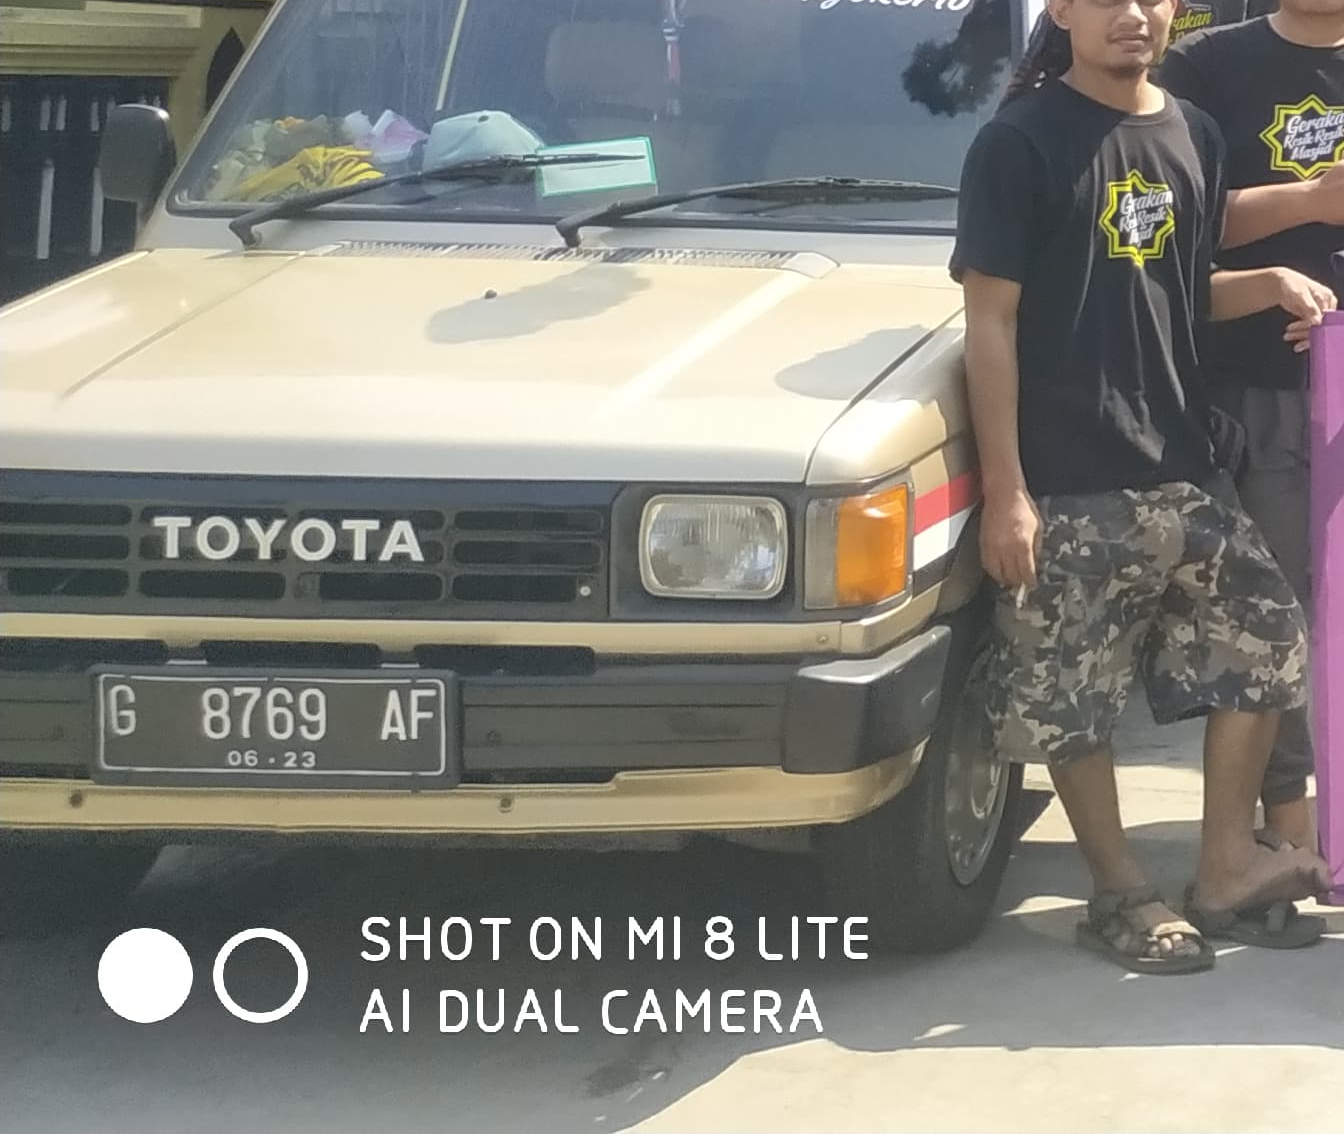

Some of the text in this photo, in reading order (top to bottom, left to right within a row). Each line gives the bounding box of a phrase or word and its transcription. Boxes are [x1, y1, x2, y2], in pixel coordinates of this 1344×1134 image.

[1290, 139, 1335, 161] Masjid
[153, 515, 425, 562] TOYOTA
[109, 683, 437, 742] G 8769 AF
